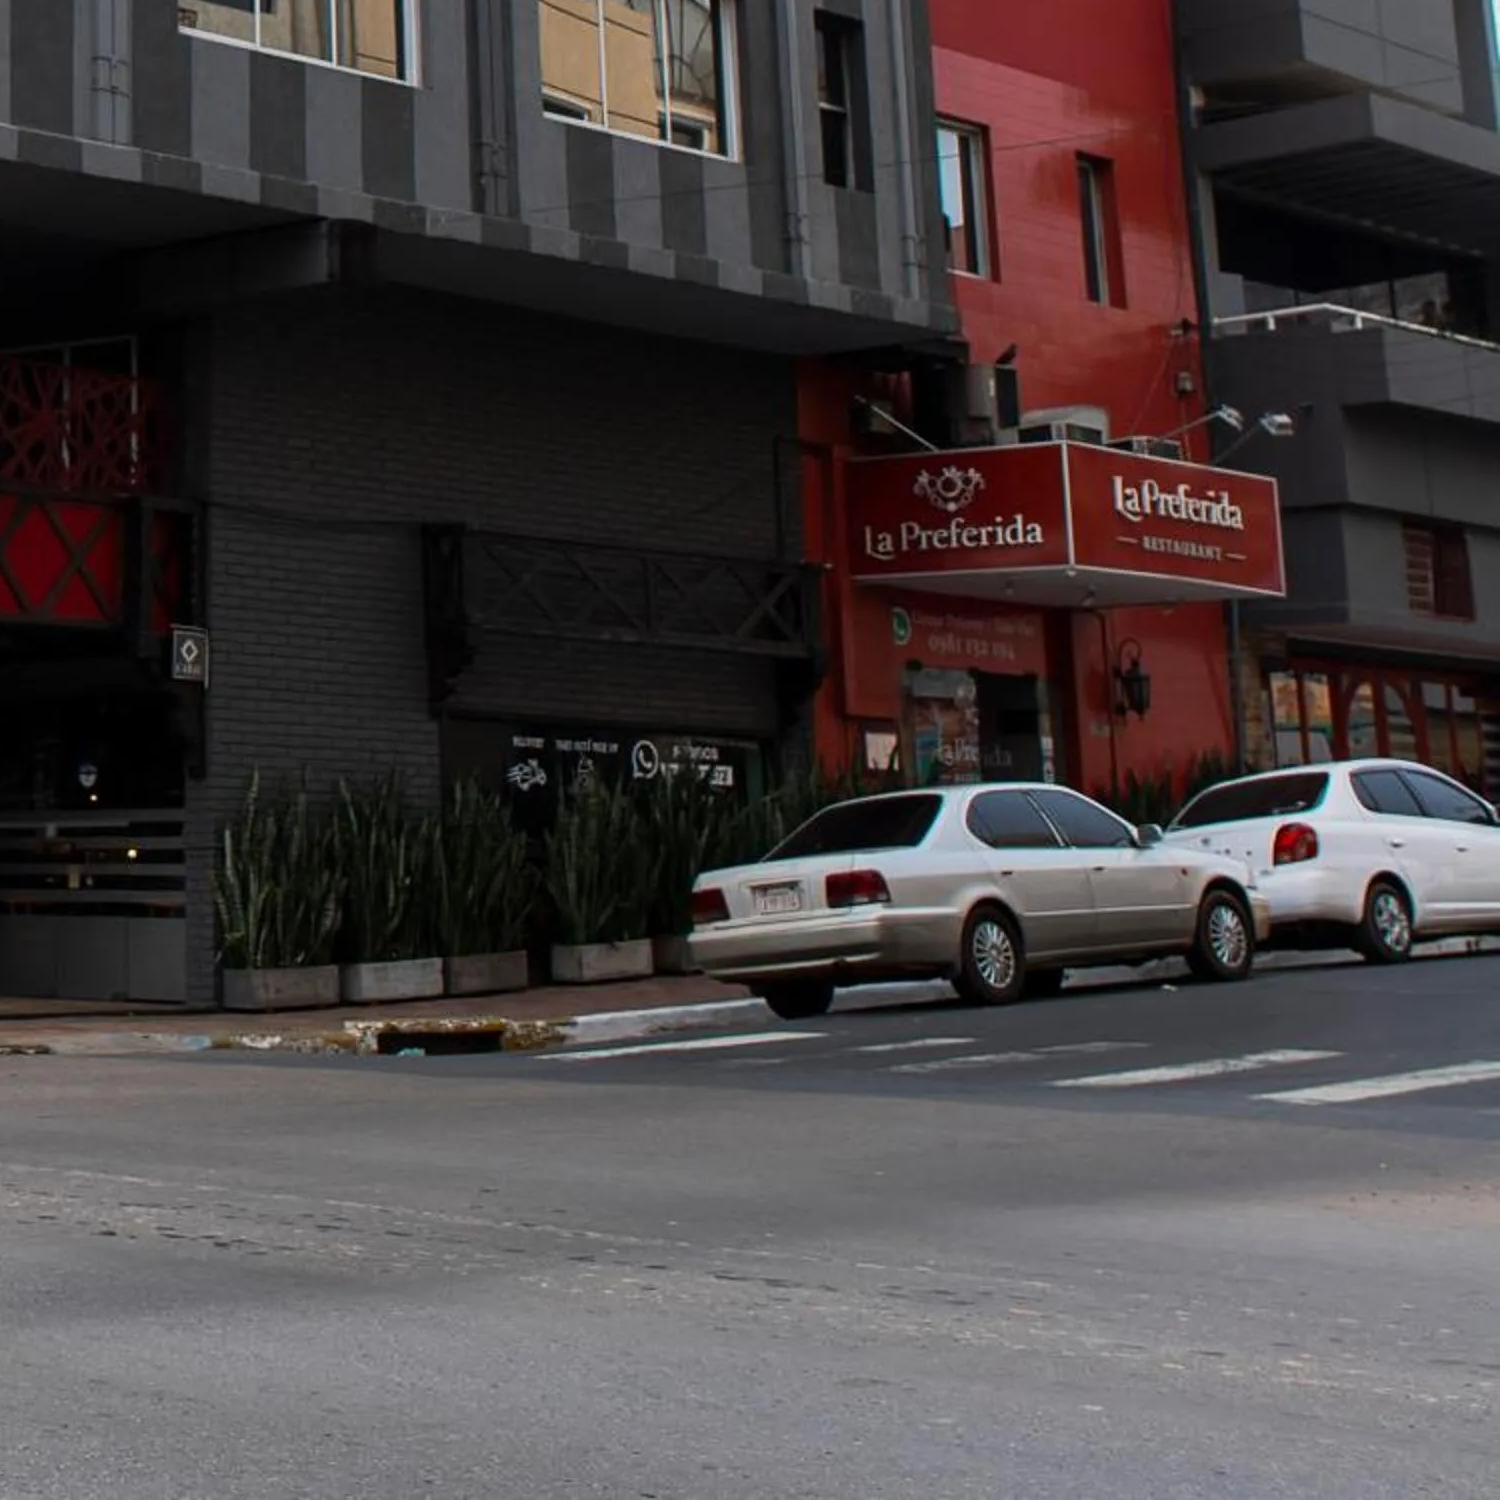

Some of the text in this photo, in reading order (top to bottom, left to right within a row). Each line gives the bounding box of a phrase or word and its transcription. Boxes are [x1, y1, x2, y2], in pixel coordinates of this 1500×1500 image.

[1113, 475, 1245, 530] La Preferida
[864, 513, 1044, 559] La Preferida
[1142, 535, 1224, 562] RESTAURANT
